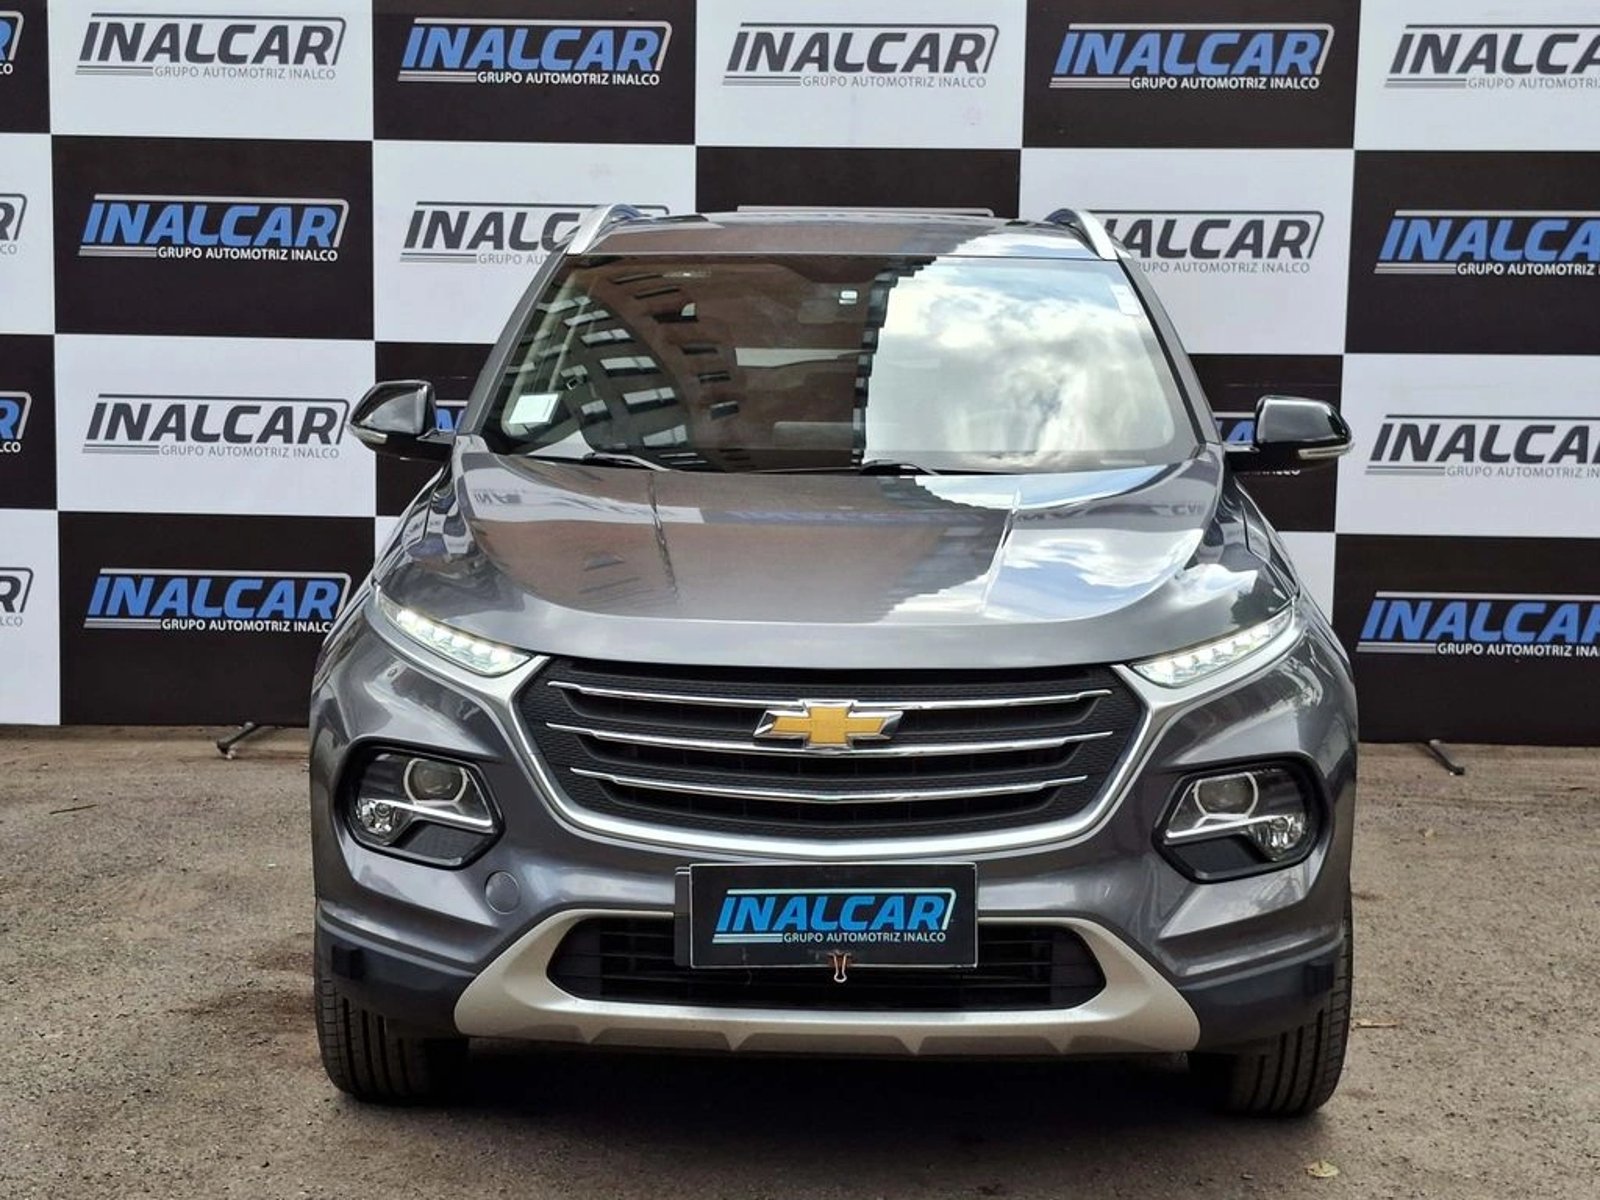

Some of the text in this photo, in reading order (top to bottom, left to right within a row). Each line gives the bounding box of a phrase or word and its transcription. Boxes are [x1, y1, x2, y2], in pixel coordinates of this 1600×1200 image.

[79, 22, 335, 65] INALCAR
[401, 27, 660, 71] INALCAR
[726, 32, 986, 73] INALCAR
[1054, 32, 1321, 76] INALCAR
[154, 66, 336, 80] GRUPO AUTOMOTRIZ INALCO
[477, 71, 660, 86] GRUPO AUTOMOTRIZ INALCO
[802, 76, 987, 88] GRUPO AUTOMOTRIZ INALCO
[1131, 77, 1320, 89] GRUPO AUTOMOTRIZ INALCO
[1468, 77, 1515, 89] GRUPO
[81, 203, 337, 247] INALCAR
[157, 246, 338, 262] GRUPO AUTOMOTRIZ INALCO
[478, 254, 523, 265] GRUPO
[1173, 262, 1259, 273] AUTOMOTRIZ
[1261, 262, 1310, 274] INALCO
[1457, 263, 1595, 276] GRUPO AUTOMOTRIZ
[86, 403, 338, 444] INALCAR
[1369, 423, 1600, 464] INALCA
[161, 445, 340, 459] GRUPO AUTOMOTRIZ INALCO
[1447, 466, 1493, 477] GRUPO
[1497, 467, 1582, 479] AUTOMOTRIZ
[88, 577, 339, 620] INALCAR
[162, 618, 333, 633] GRUPO AUTOMOTRIZ INALC
[1437, 643, 1483, 655] GRUPO
[1486, 644, 1572, 657] AUTOMOTRIZ
[716, 896, 945, 931] INALCAR
[784, 931, 946, 943] GRUPO AUTOMOTRIZ INALCO
